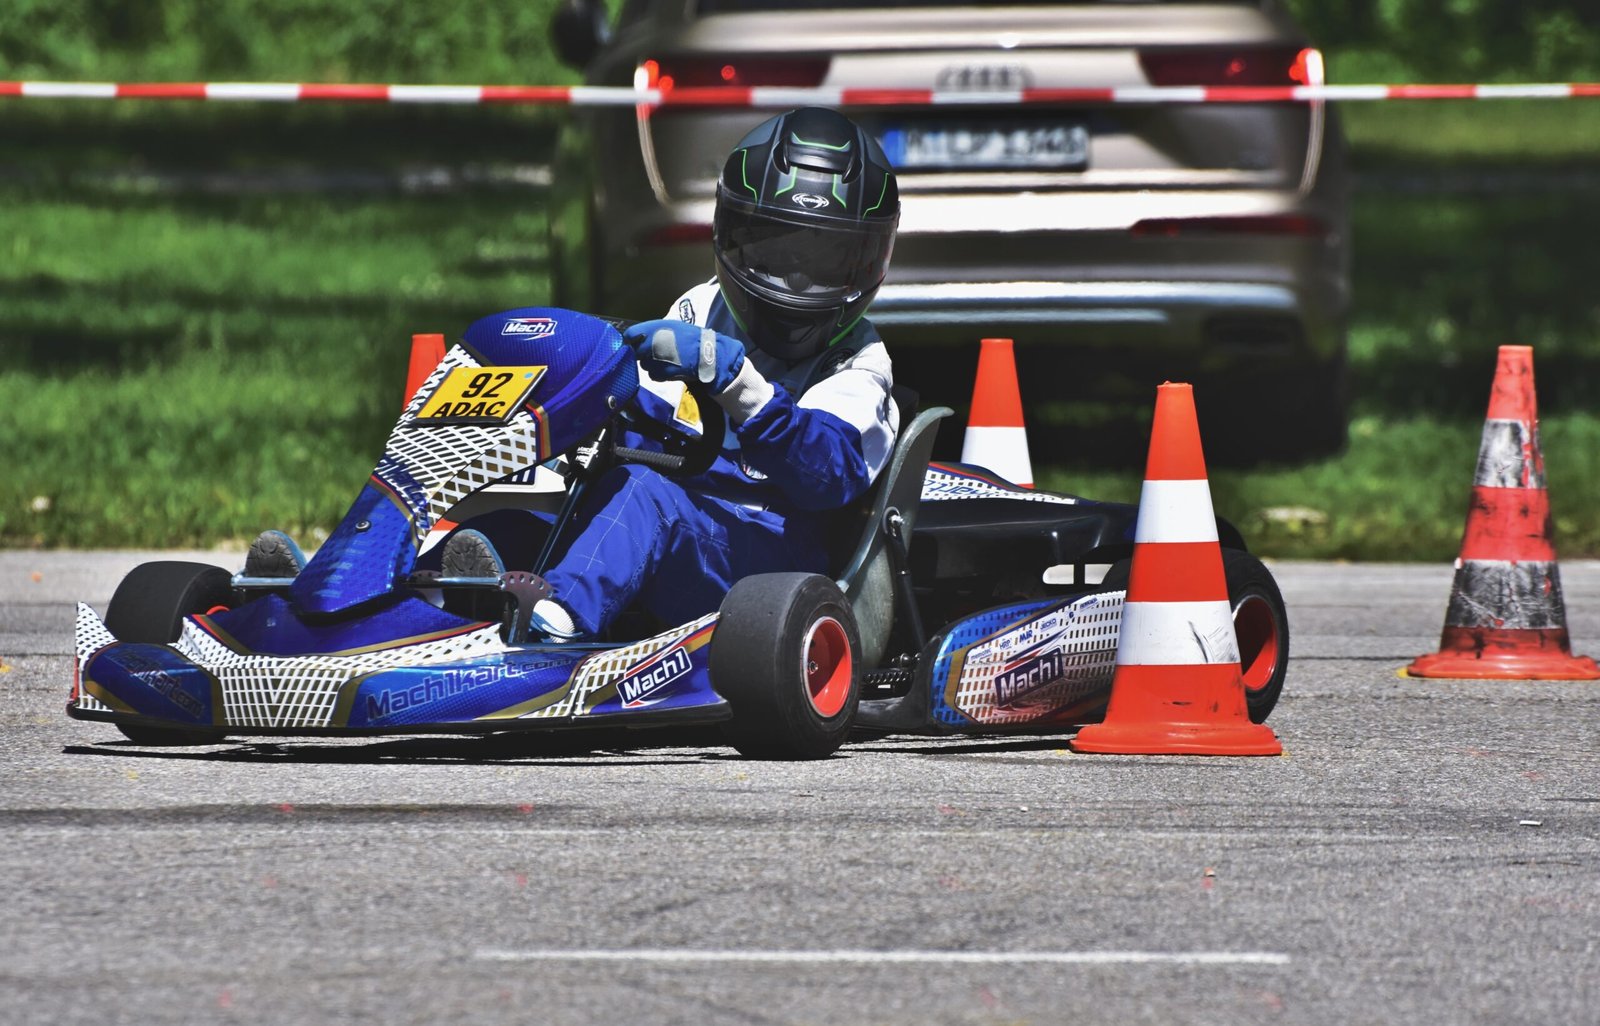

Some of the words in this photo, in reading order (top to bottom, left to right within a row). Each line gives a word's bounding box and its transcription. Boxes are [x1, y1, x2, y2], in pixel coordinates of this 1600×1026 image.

[505, 322, 554, 333] Mach1
[461, 373, 514, 398] 92
[430, 401, 506, 418] ADAC
[366, 659, 572, 723] Mach1kart.com
[623, 650, 686, 701] Mach1
[1000, 652, 1059, 702] Mach1
